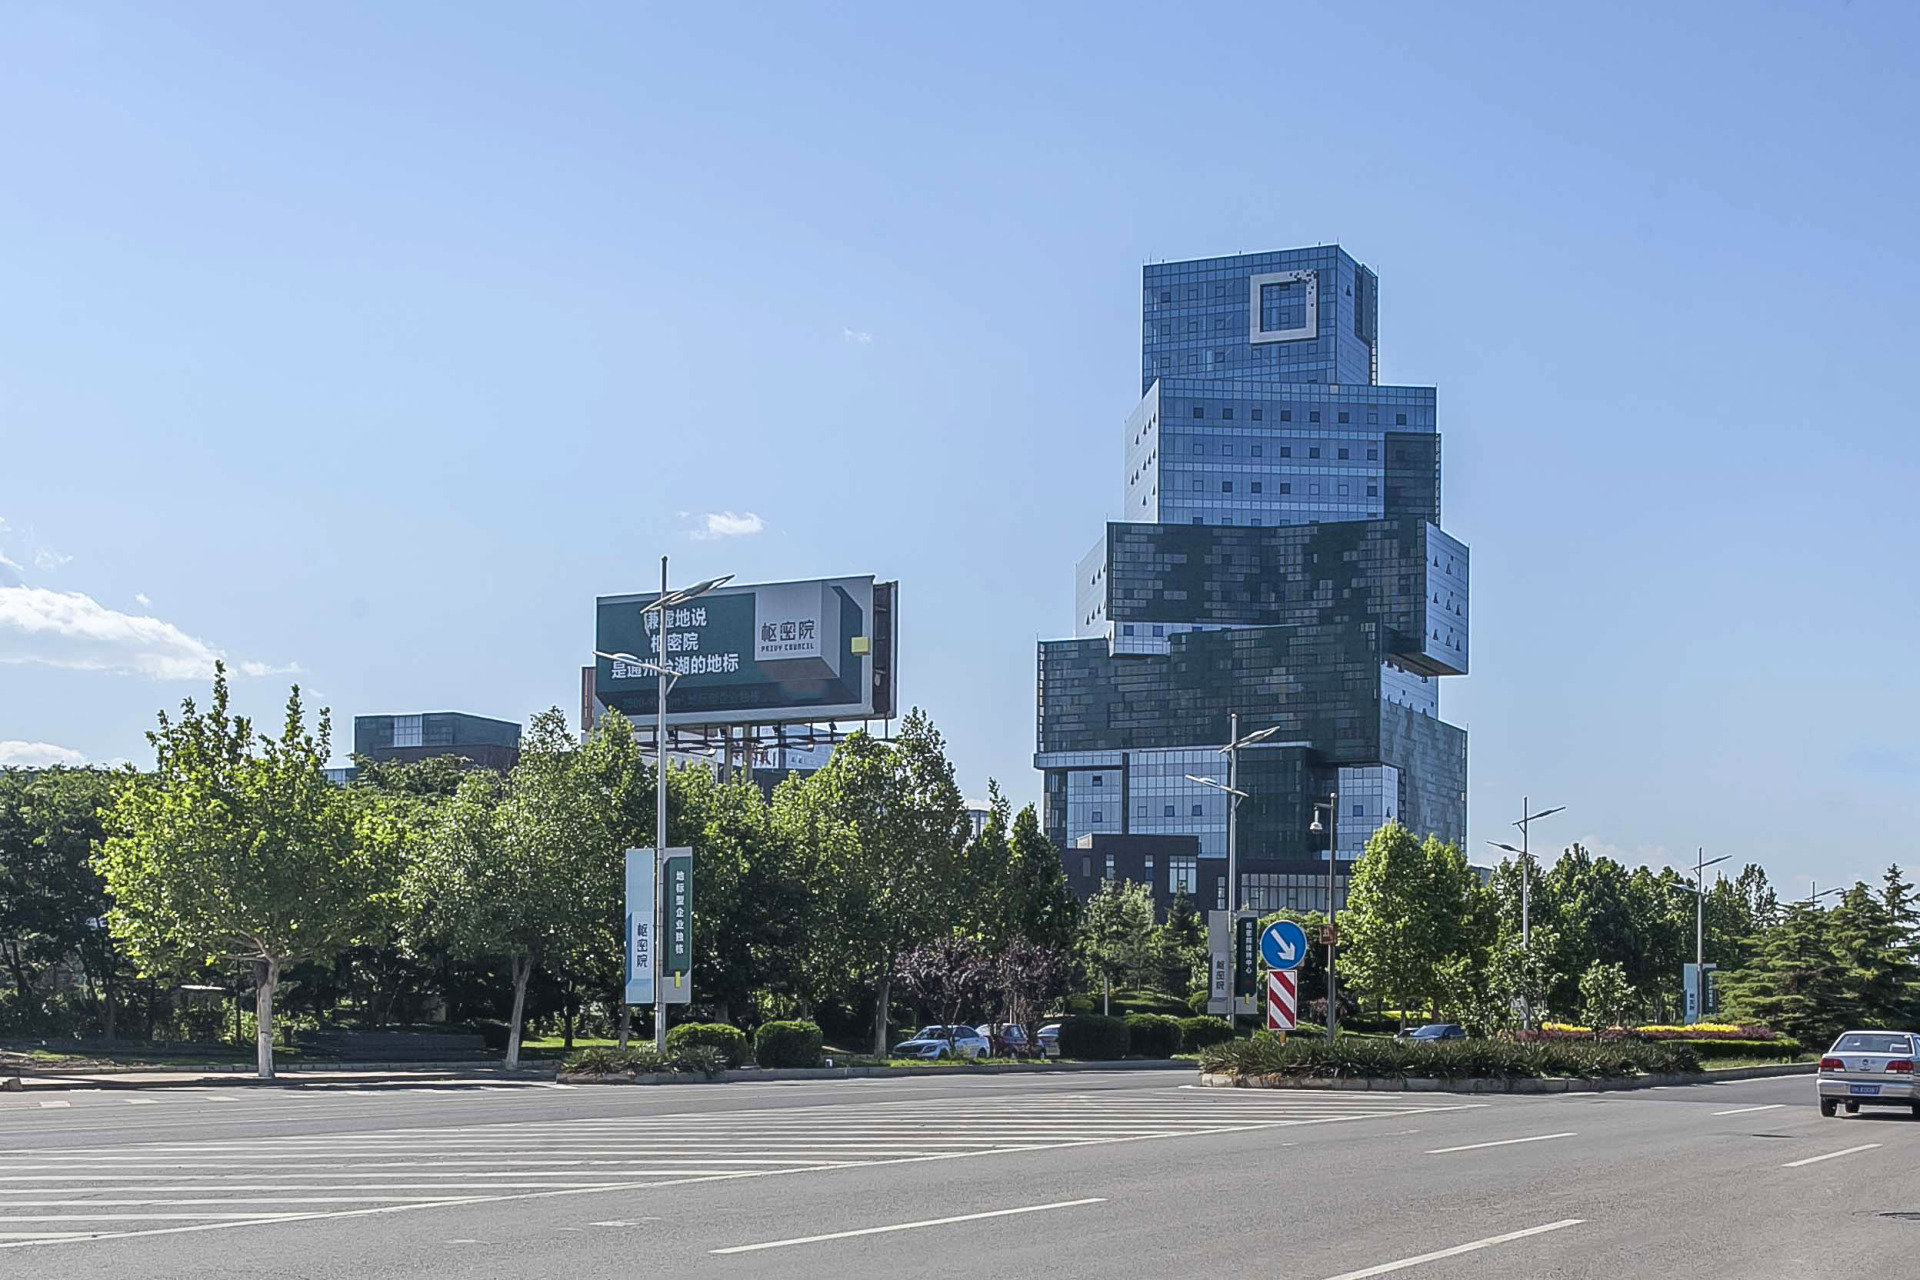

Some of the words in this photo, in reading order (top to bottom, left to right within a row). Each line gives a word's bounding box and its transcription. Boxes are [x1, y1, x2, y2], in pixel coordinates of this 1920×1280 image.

[761, 619, 815, 642] 枢密院
[761, 645, 783, 653] PRIVY
[784, 642, 815, 651] COUNCIL
[637, 922, 648, 967] 枢密院
